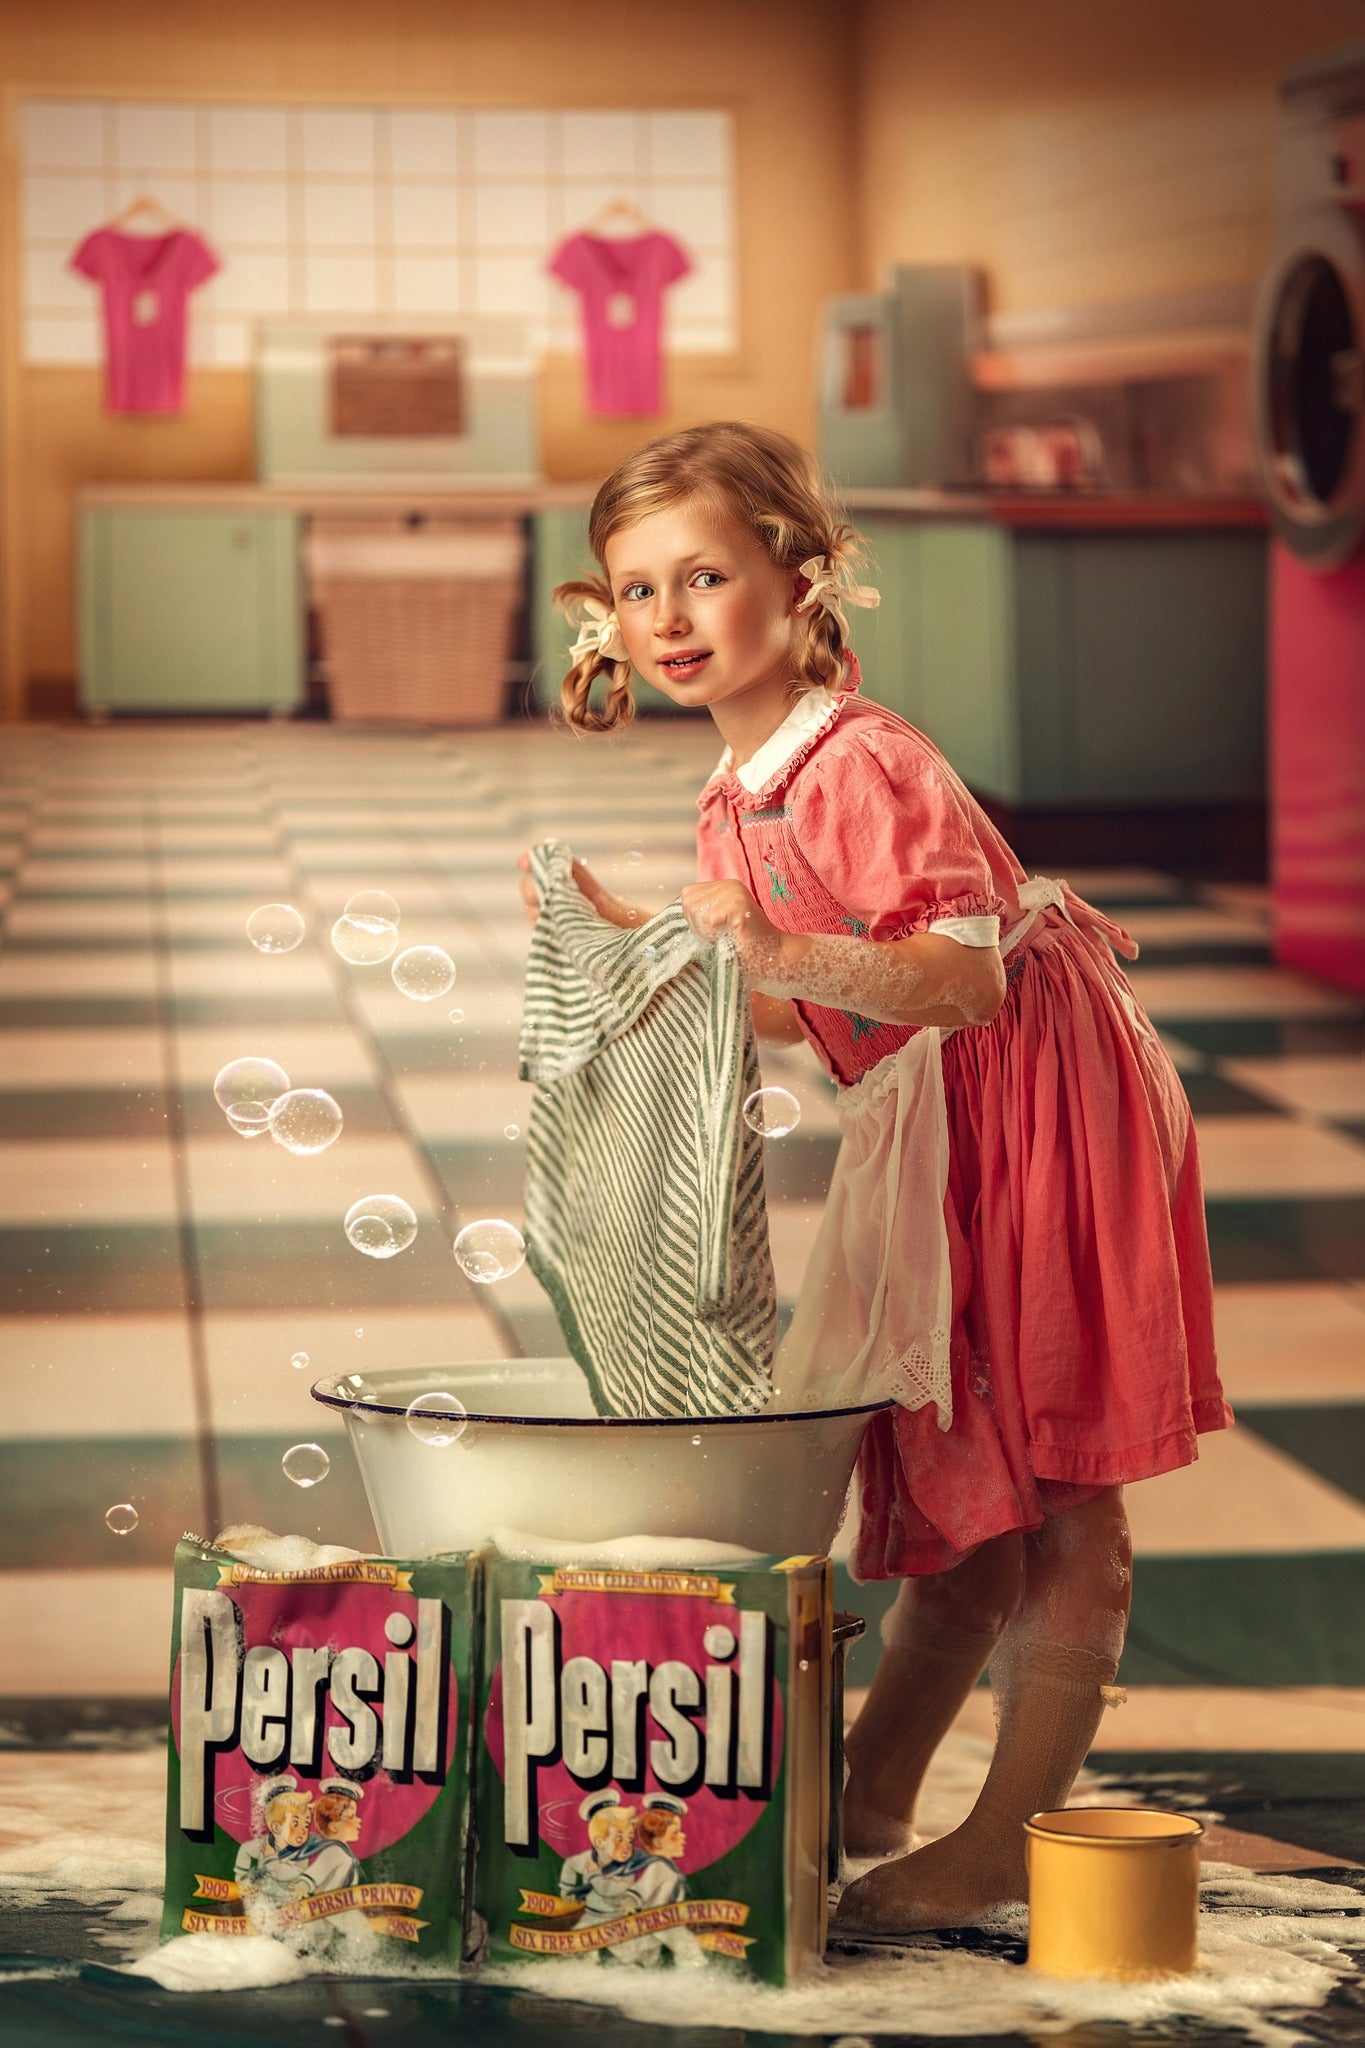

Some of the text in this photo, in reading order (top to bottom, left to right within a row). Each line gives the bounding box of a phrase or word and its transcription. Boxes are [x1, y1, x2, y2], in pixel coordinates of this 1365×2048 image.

[366, 1565, 394, 1581] PACK
[180, 1587, 450, 1840] Persil
[501, 1598, 772, 1854] Persil
[187, 1914, 210, 1933] SIX
[307, 1892, 359, 1918] PERSIL
[360, 1885, 417, 1906] PRINTS
[201, 1879, 230, 1899] 1909
[526, 1894, 556, 1914] 1909
[514, 1928, 537, 1948] SIX
[540, 1933, 577, 1952] FREE
[634, 1906, 685, 1934] PERSIL
[686, 1902, 743, 1922] PRINTS
